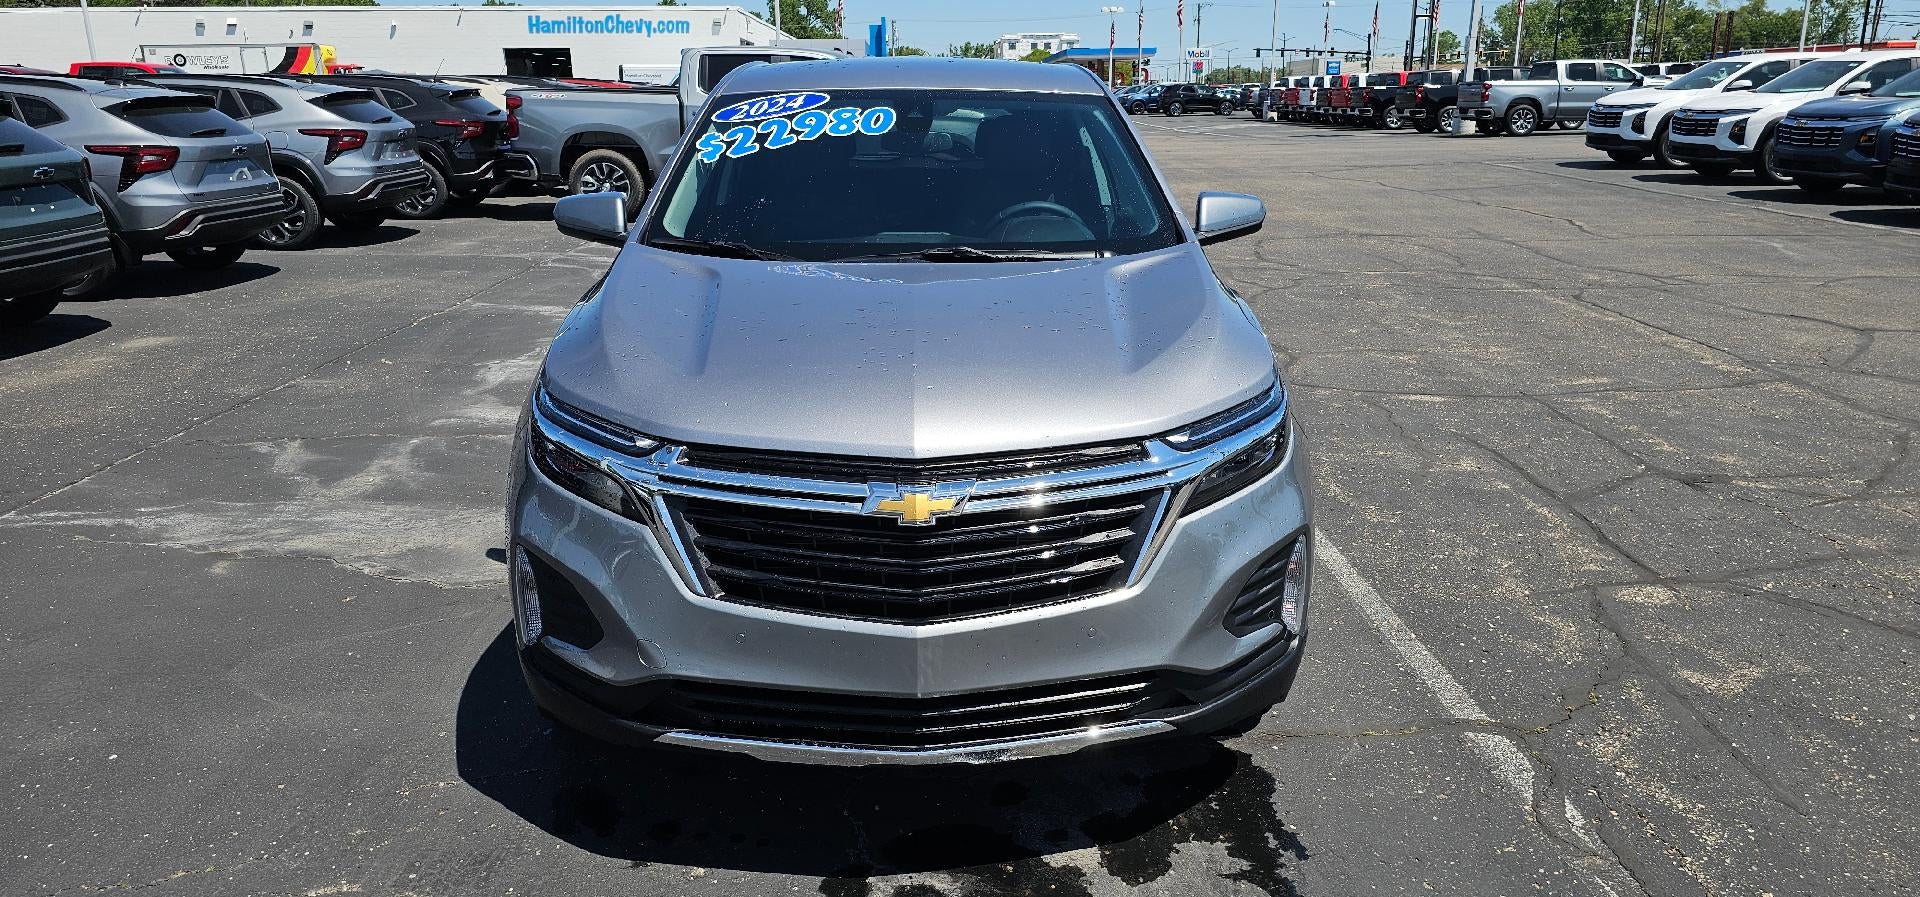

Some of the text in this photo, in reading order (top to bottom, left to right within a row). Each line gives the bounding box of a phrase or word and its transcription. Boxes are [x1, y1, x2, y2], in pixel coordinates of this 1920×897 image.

[527, 14, 690, 37] HamiltonChevy.com
[1187, 50, 1210, 58] Mobil
[728, 94, 806, 121] 2024
[696, 106, 897, 163] $22980
